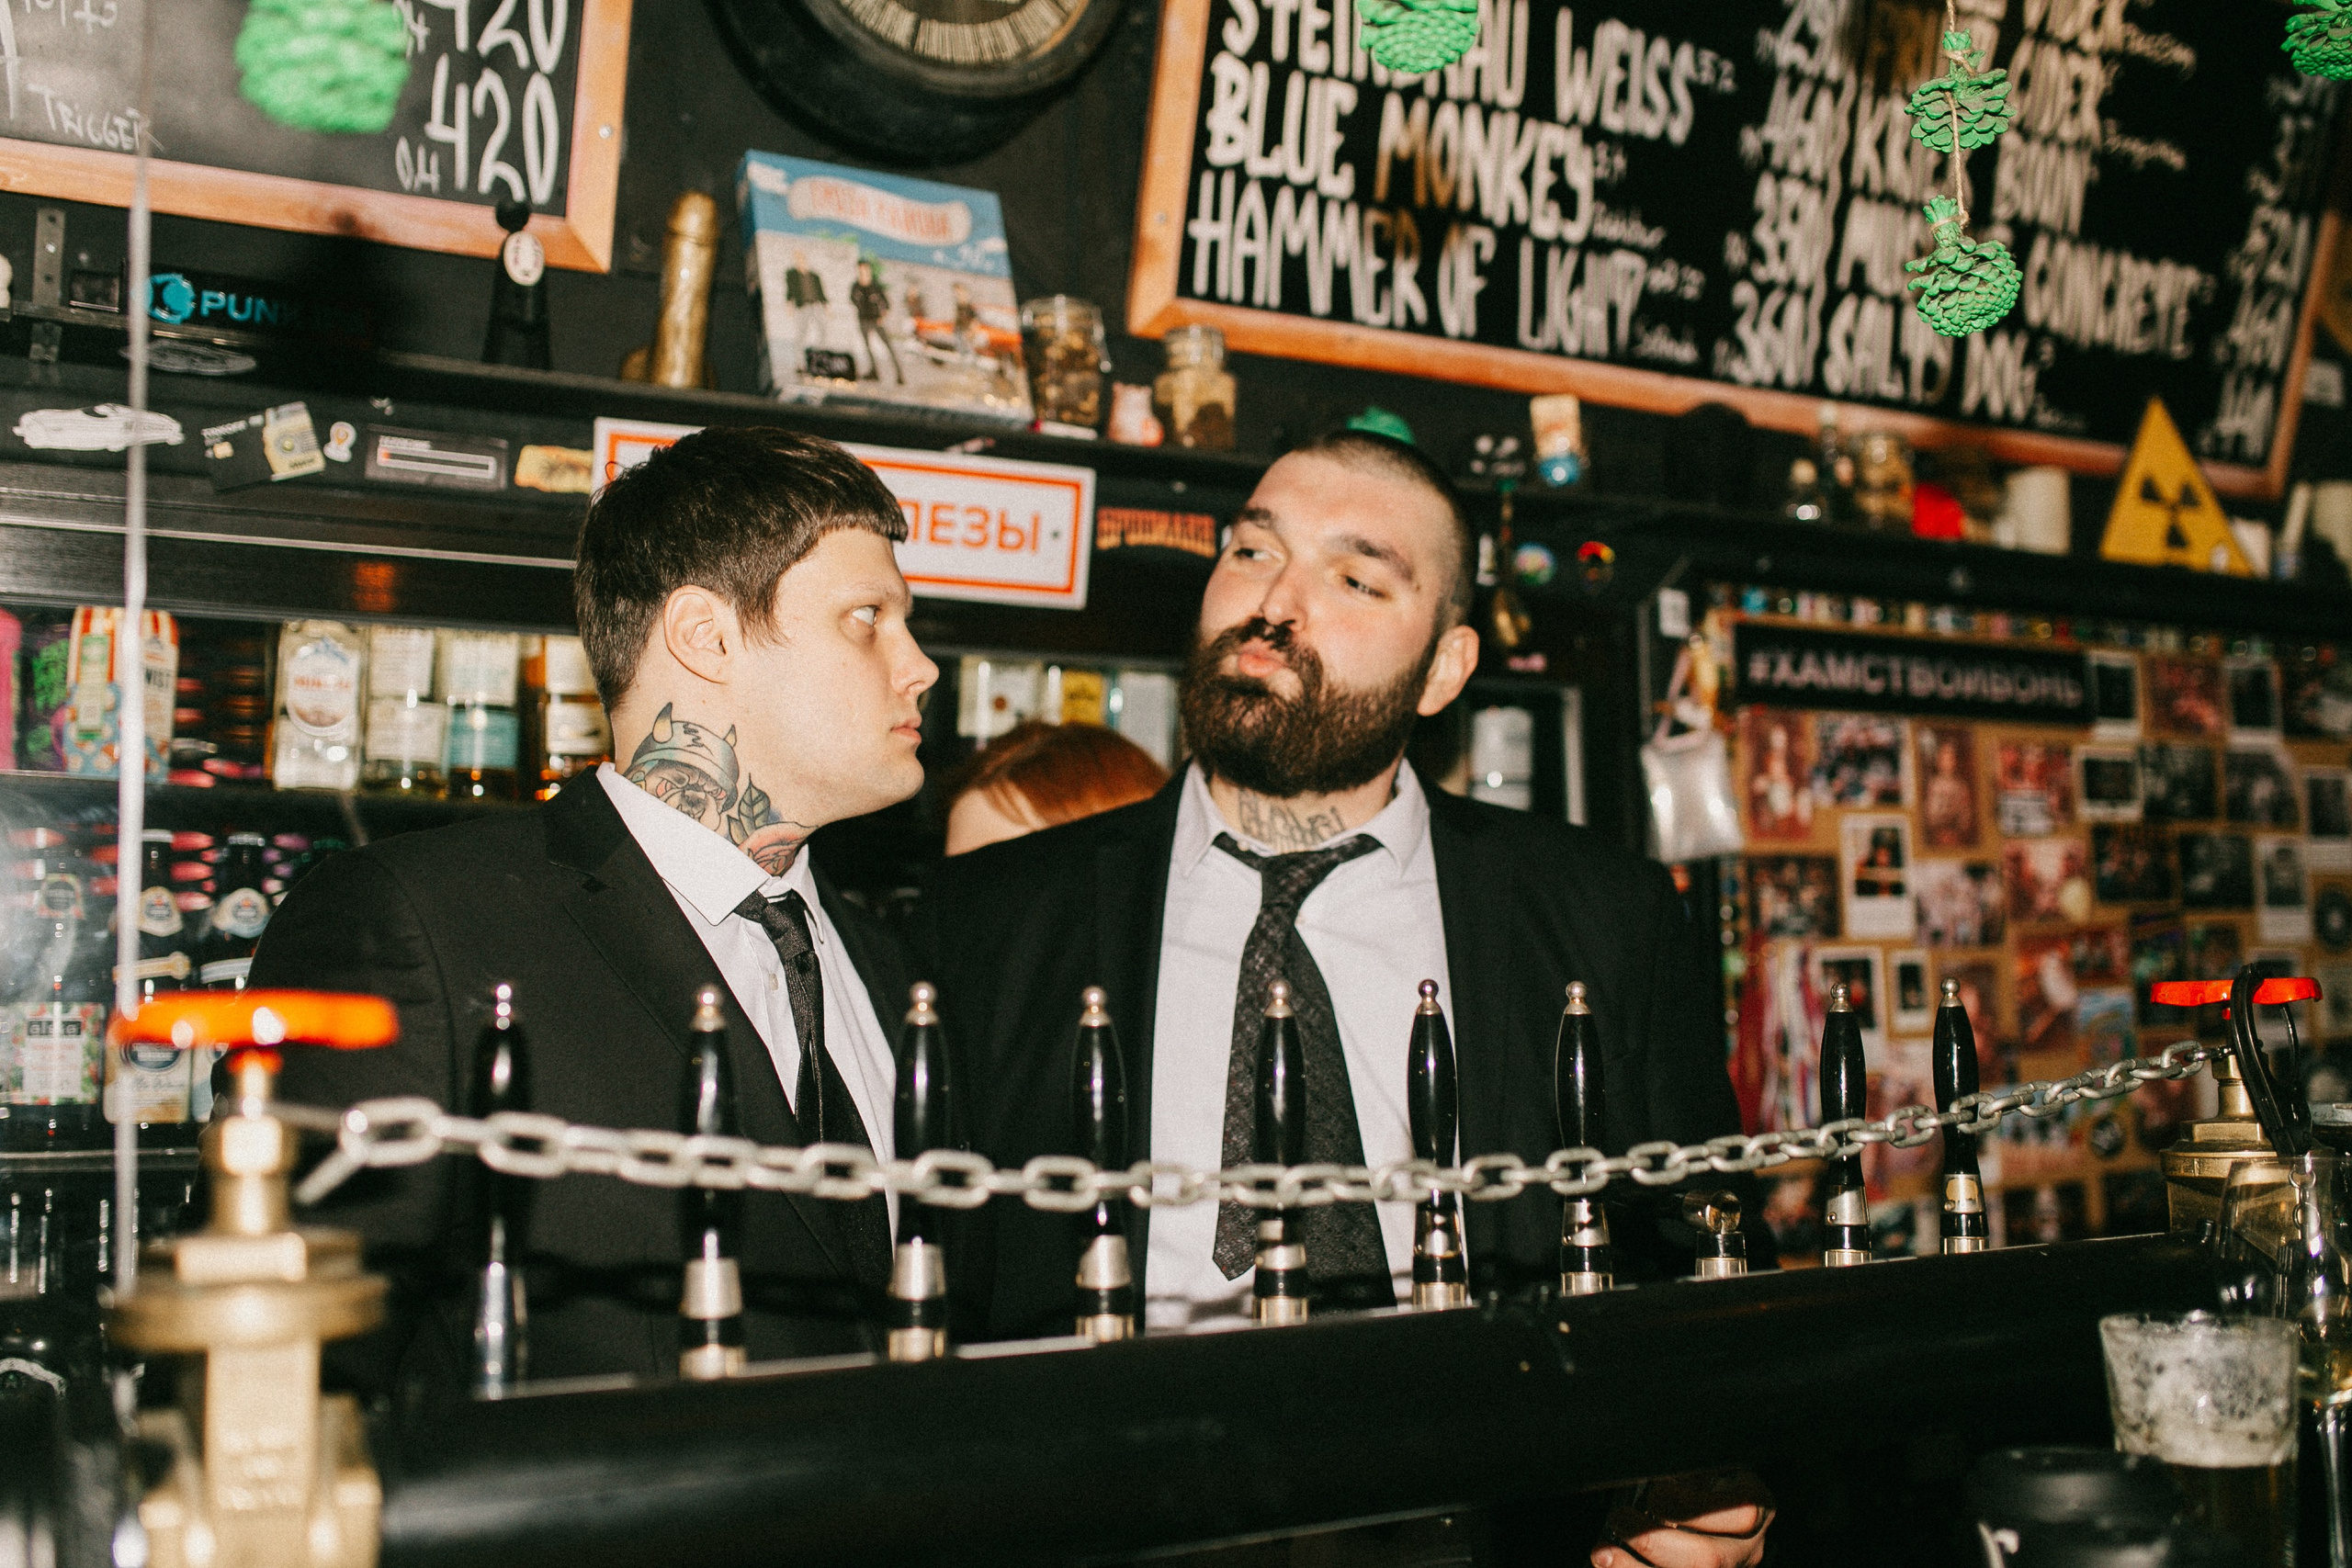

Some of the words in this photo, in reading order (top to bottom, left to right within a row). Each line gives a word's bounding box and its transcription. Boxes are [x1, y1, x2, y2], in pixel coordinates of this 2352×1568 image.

[424, 53, 559, 204] 420
[1205, 51, 1358, 199] BLUE
[1374, 92, 1594, 244] MONKEY
[1555, 6, 1694, 145] WEISS
[1188, 168, 1428, 329] HAMMER
[1437, 220, 1497, 338] OF
